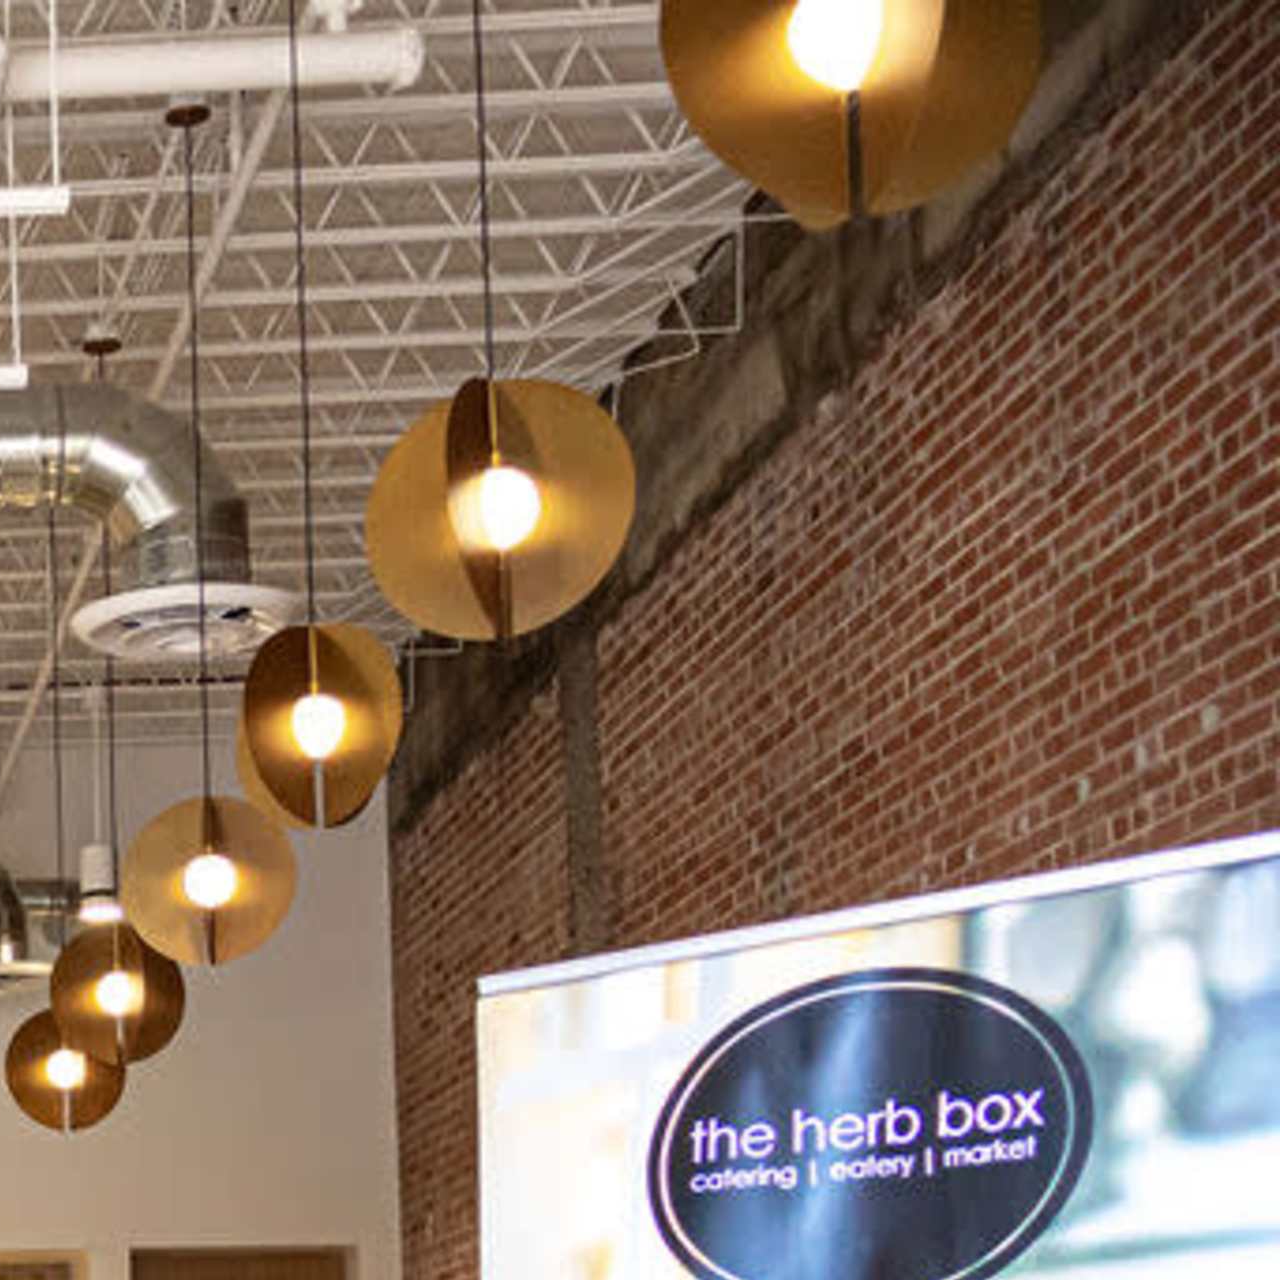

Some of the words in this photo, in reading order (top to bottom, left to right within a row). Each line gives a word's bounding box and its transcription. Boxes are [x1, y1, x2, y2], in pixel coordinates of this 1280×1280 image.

[689, 1115, 776, 1164] the
[791, 1099, 922, 1154] herb
[937, 1088, 1047, 1138] box
[689, 1164, 798, 1194] catering
[828, 1151, 915, 1181] eatery
[942, 1135, 1039, 1168] market
